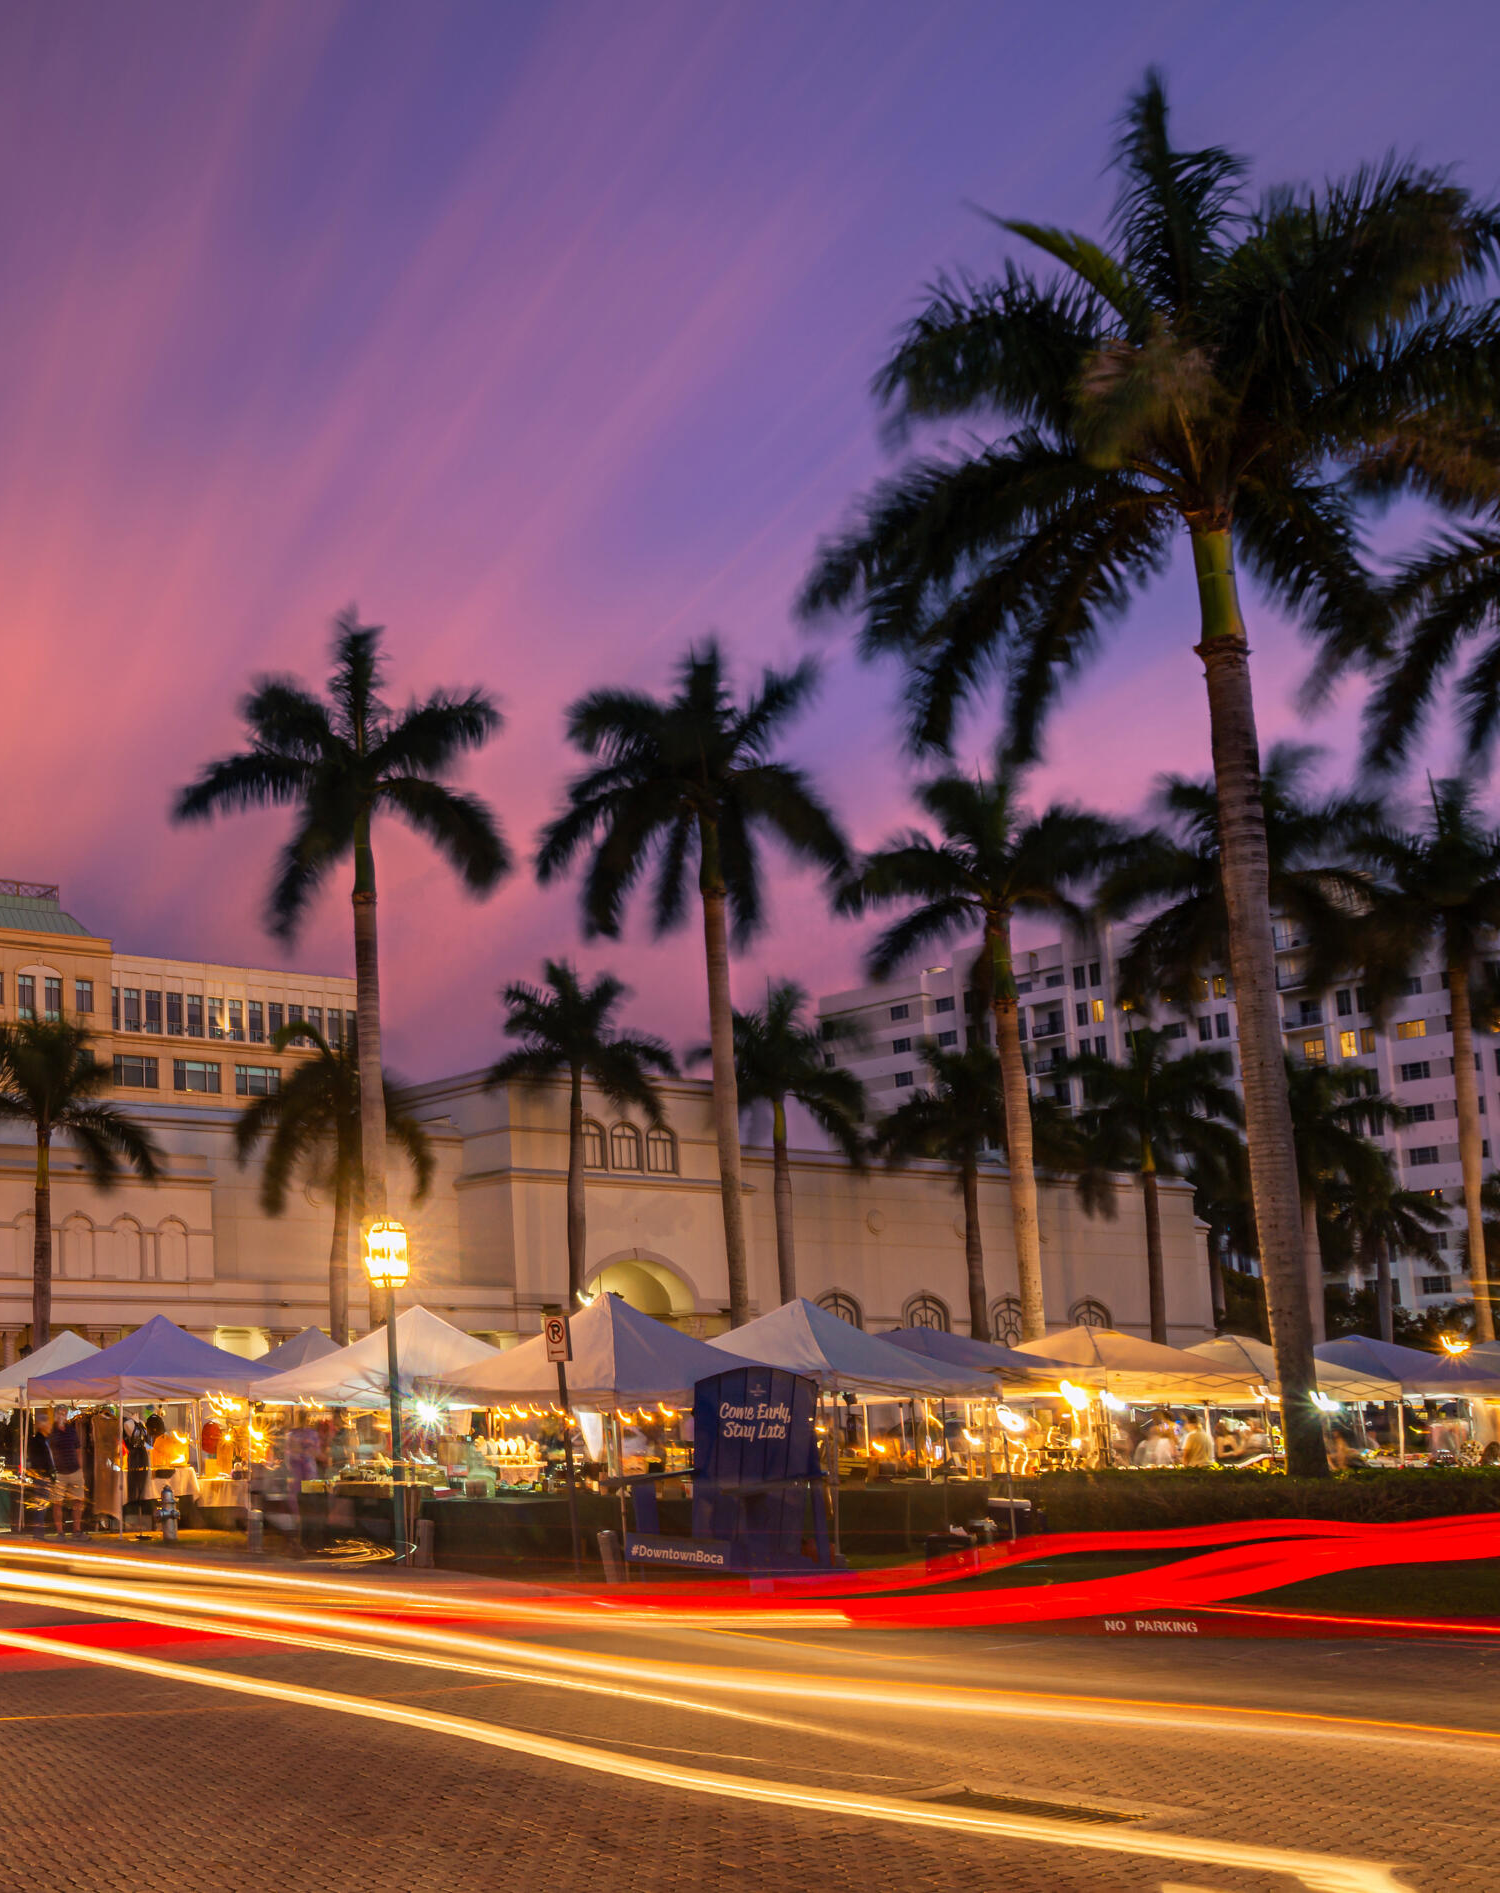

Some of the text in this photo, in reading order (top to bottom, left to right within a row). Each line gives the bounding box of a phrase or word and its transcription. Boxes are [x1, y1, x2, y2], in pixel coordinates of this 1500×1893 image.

[719, 1402, 754, 1420] Come
[723, 1421, 786, 1442] Stay Late
[631, 1545, 724, 1565] #DowntownBoca
[1104, 1620, 1199, 1633] NO PARKING
